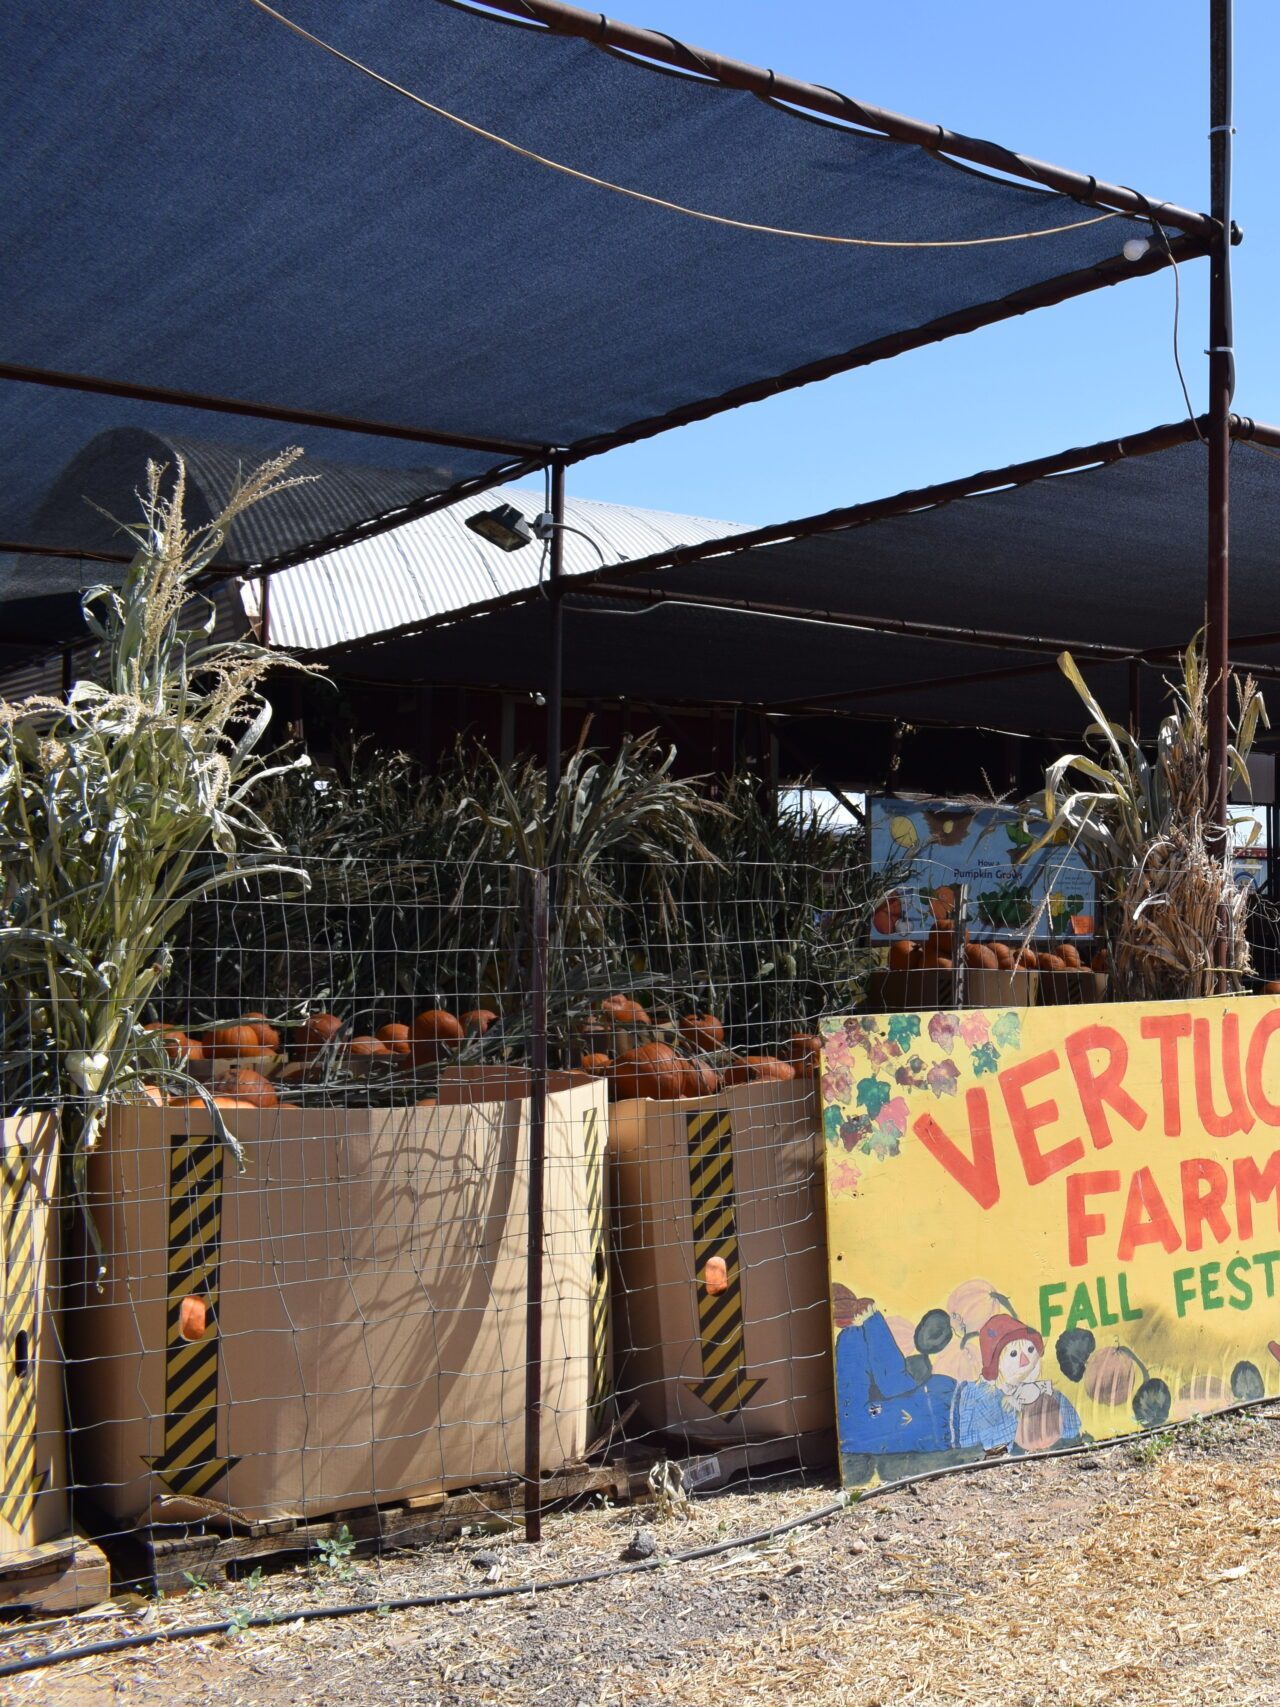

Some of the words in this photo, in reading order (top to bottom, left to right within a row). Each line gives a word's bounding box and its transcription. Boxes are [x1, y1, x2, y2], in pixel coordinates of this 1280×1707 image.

[978, 859, 994, 867] How
[954, 868, 993, 880] Pumpkin
[1039, 1272, 1142, 1337] FALL
